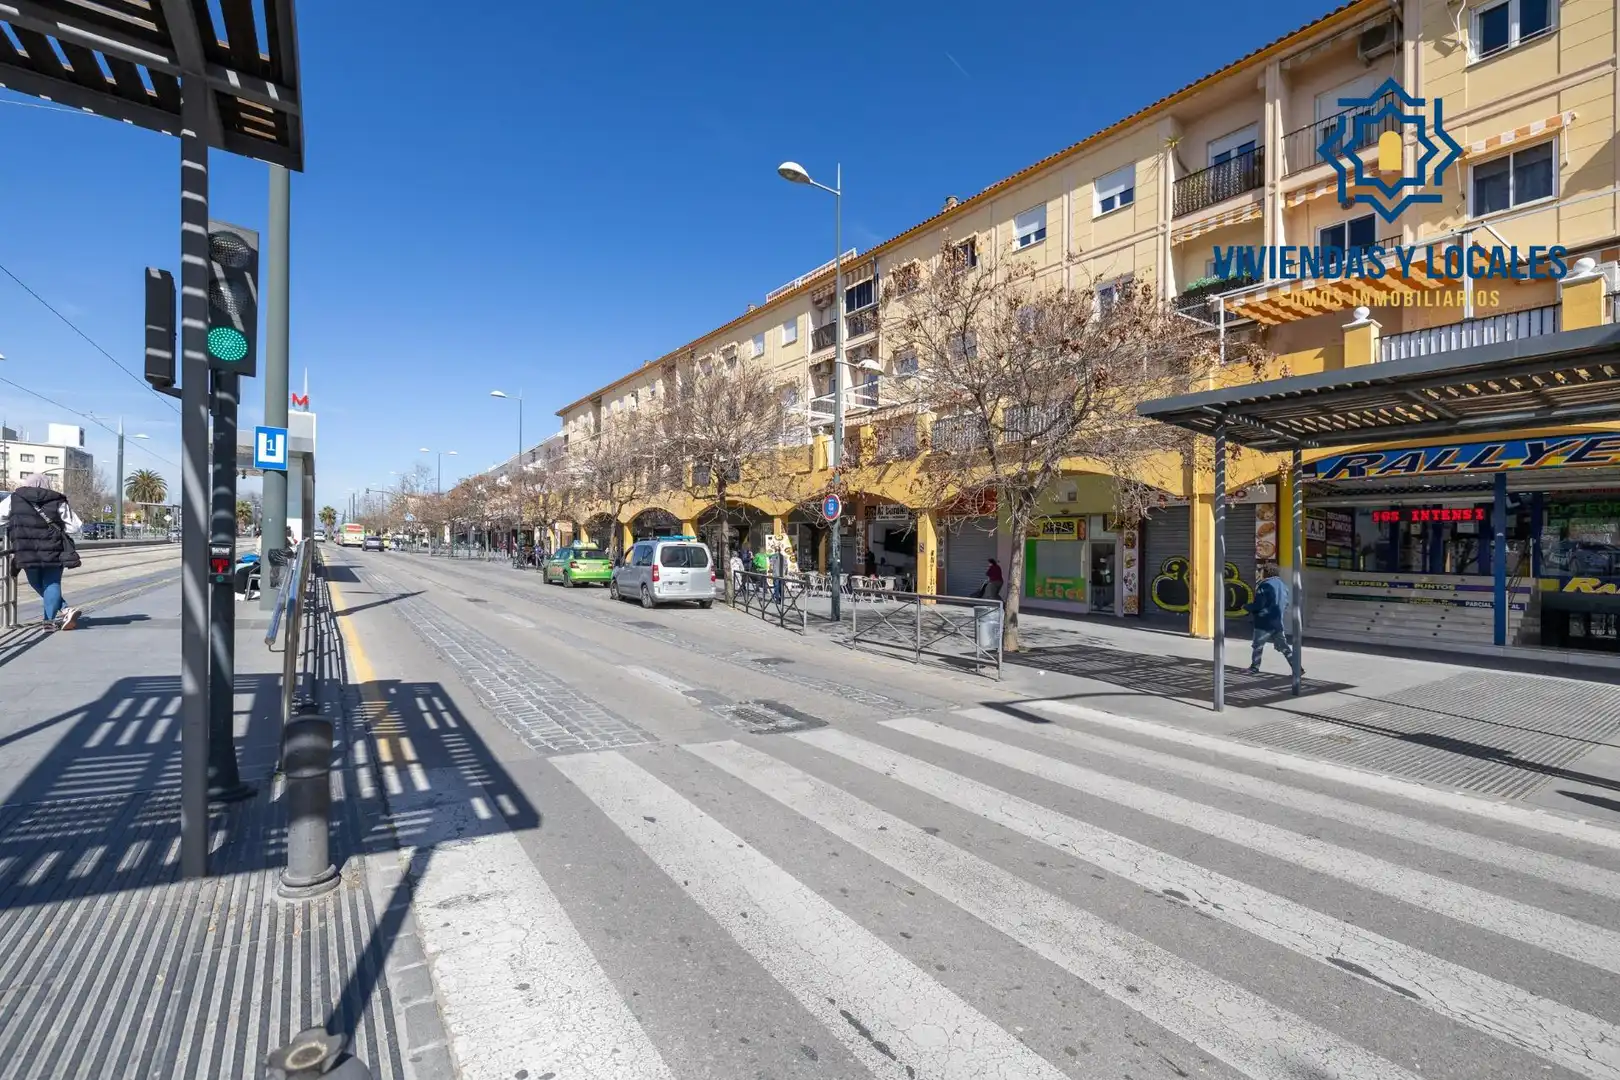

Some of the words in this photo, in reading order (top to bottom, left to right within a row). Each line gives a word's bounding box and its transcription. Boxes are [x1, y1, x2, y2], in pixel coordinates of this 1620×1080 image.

[266, 439, 276, 452] 1
[1321, 435, 1620, 480] RALLYE
[1338, 580, 1389, 588] RECUPERA
[1413, 583, 1455, 591] PUNTOS
